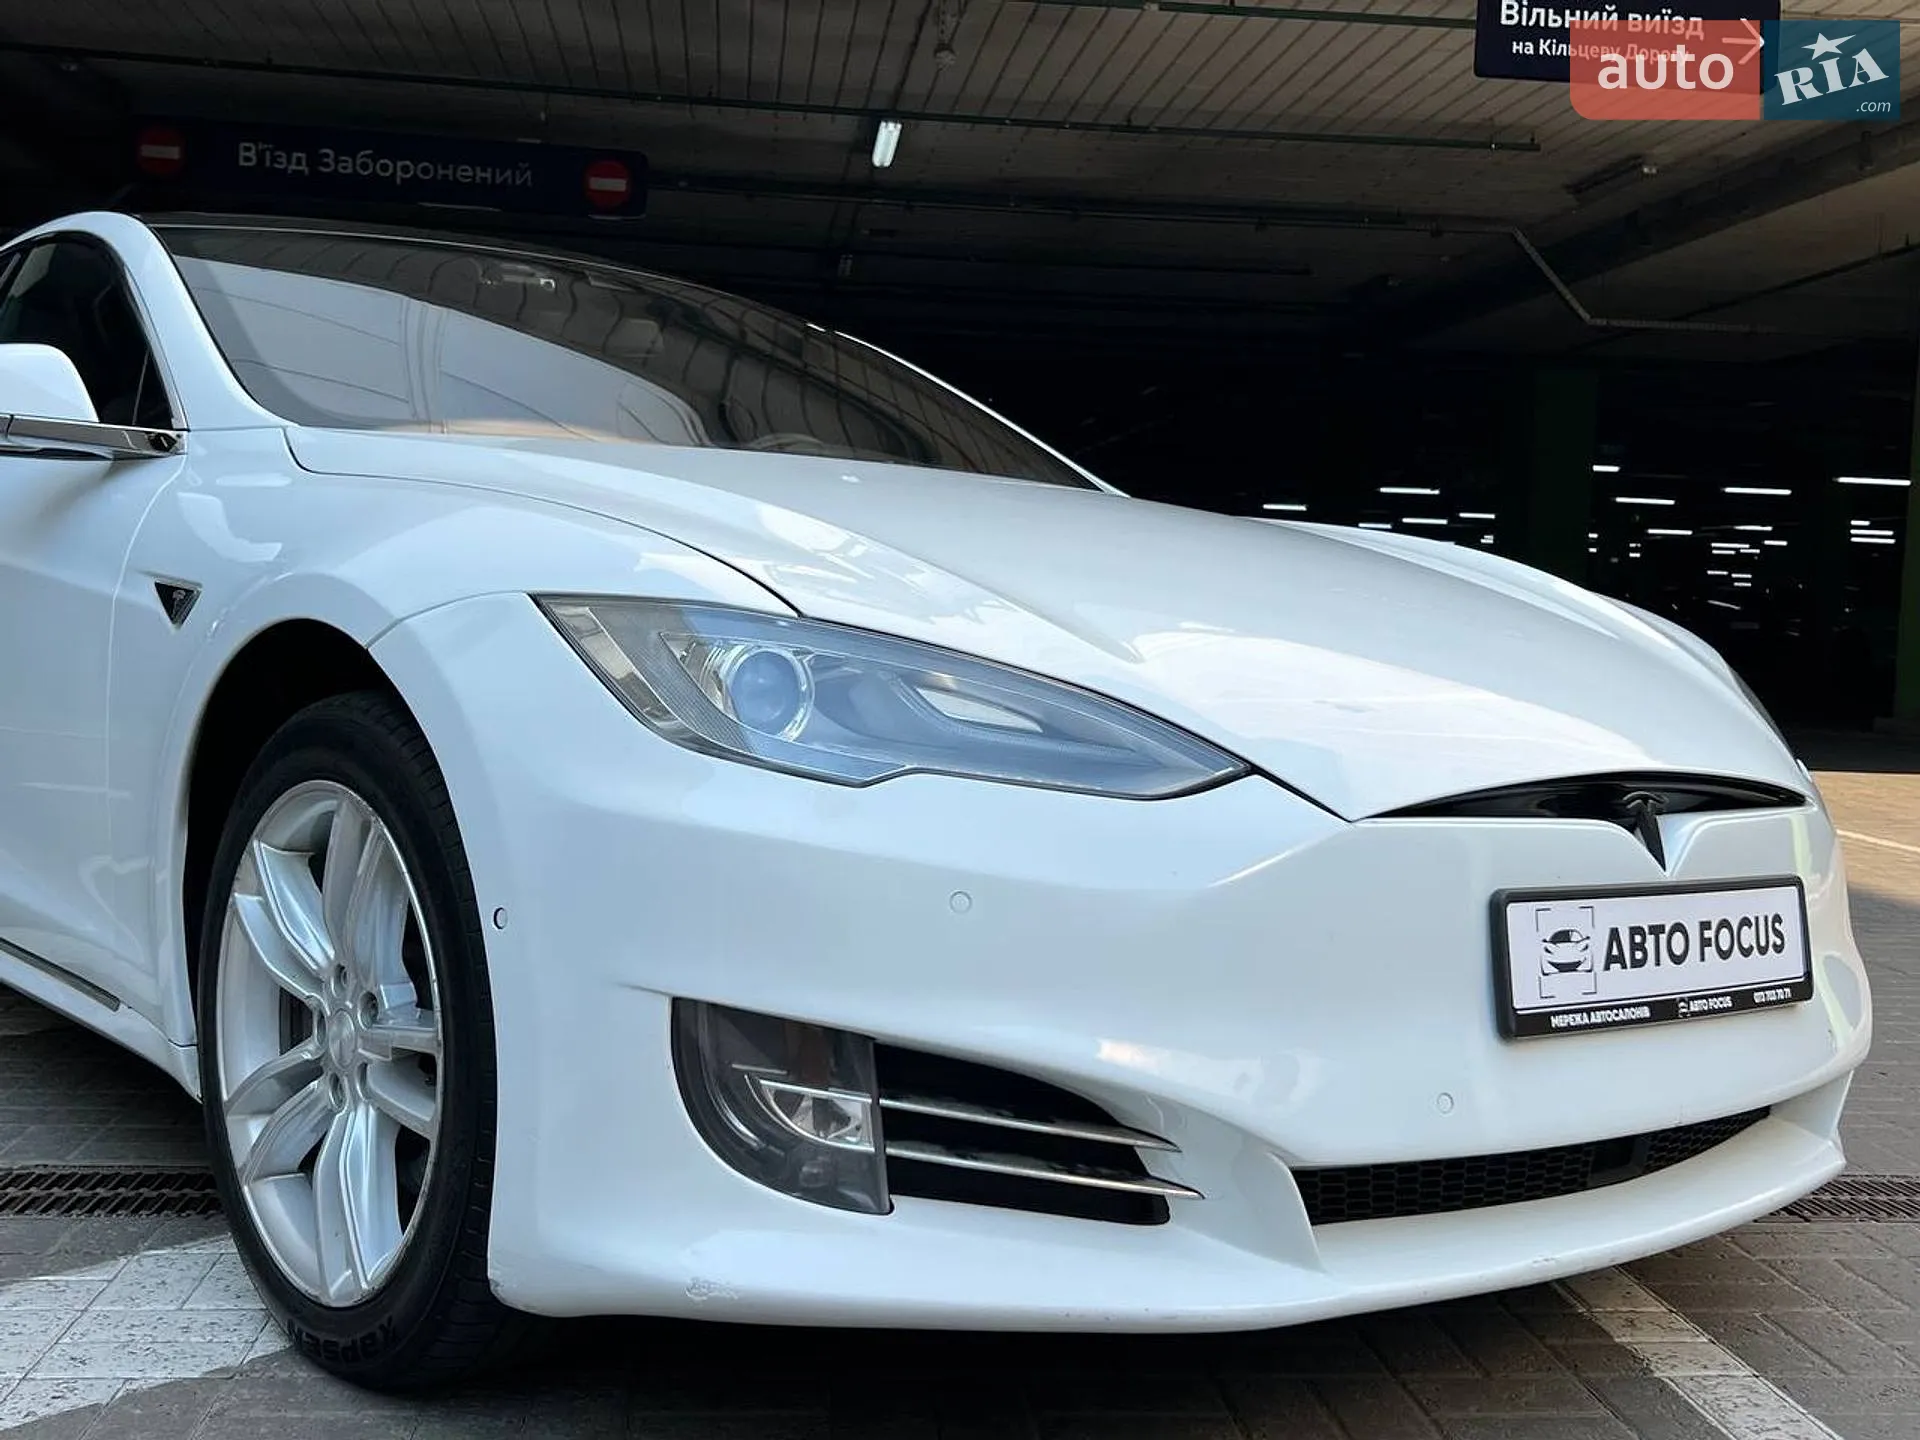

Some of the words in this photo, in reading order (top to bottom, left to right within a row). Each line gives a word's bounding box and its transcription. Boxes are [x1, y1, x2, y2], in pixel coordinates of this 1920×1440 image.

[1500, 0, 1618, 31] Вільний
[1627, 8, 1704, 41] виїзд
[1511, 40, 1535, 55] на
[317, 147, 533, 187] Заборонений
[1603, 921, 1690, 971] АВТО
[1699, 913, 1785, 962] FOCUS
